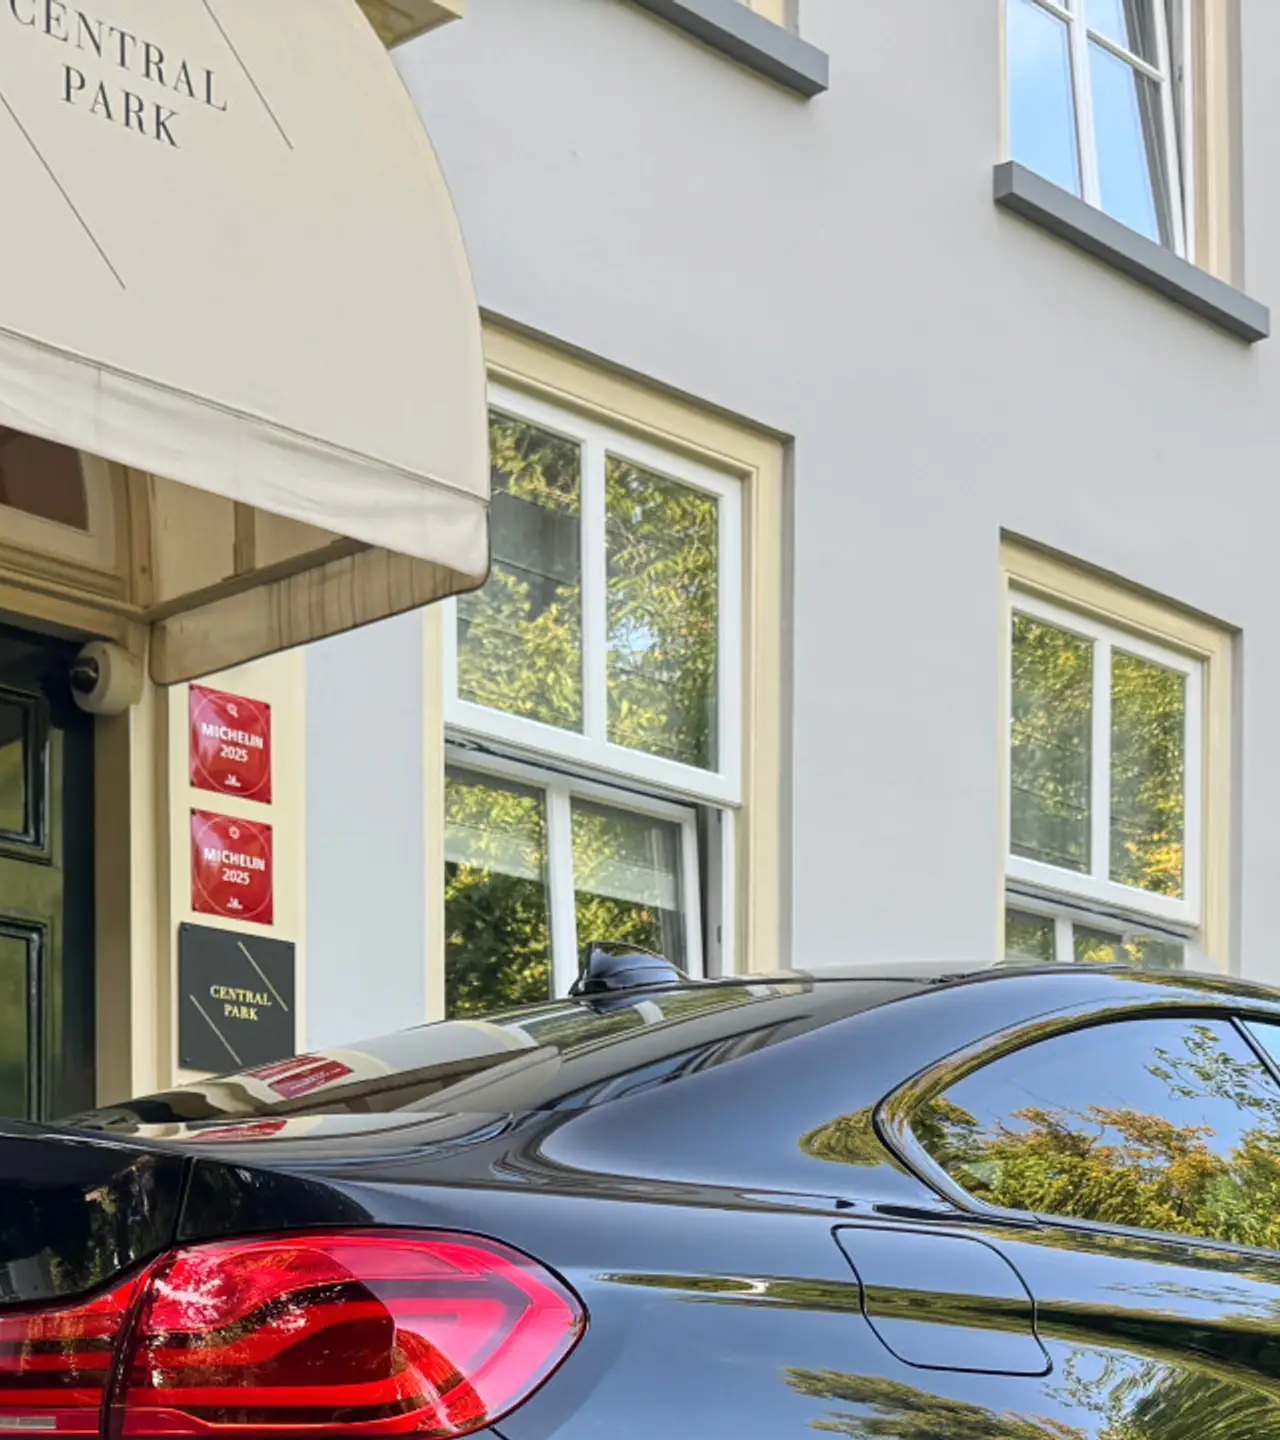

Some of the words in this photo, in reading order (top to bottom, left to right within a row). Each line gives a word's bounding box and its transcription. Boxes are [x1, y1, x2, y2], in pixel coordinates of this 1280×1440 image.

[9, 0, 228, 112] CENTRAL
[61, 63, 181, 149] PARK
[201, 722, 264, 750] MICHELIN
[220, 744, 249, 763] 2025
[203, 847, 266, 872] MICHELIN
[222, 867, 252, 886] 2025
[209, 984, 273, 1007] CENTRAL
[223, 1003, 259, 1021] PARK
